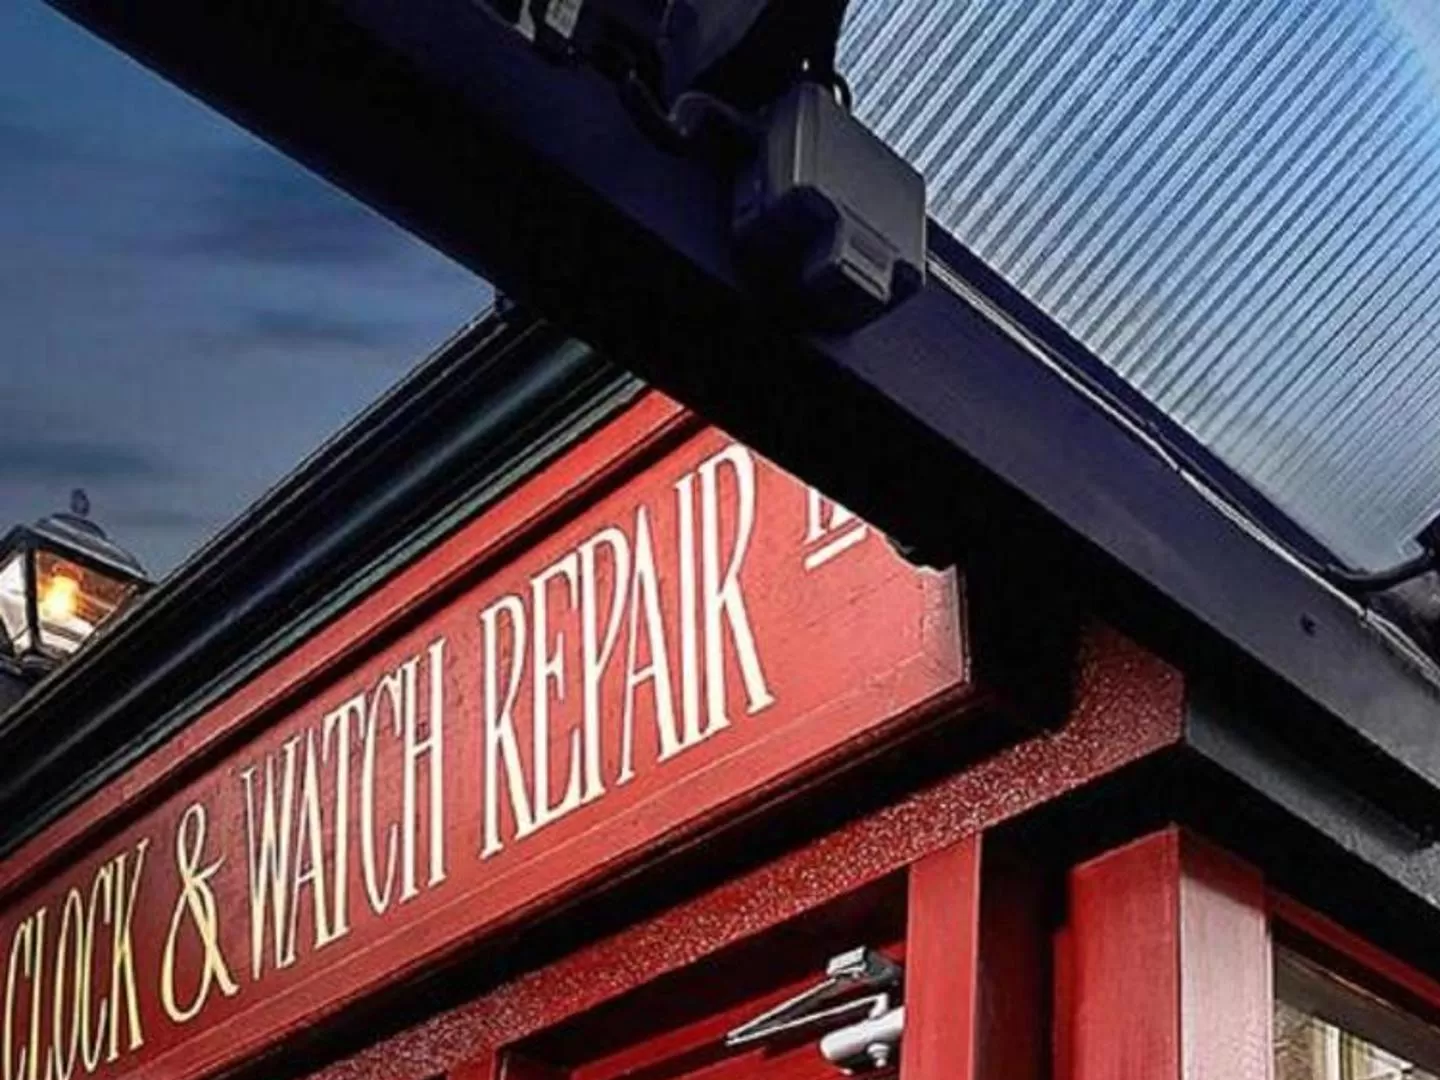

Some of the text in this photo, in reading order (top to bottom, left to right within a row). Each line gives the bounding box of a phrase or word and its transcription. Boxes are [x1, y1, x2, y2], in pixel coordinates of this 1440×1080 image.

[161, 802, 240, 1023] &
[241, 639, 447, 981] WATCH
[479, 443, 775, 861] REPAIR
